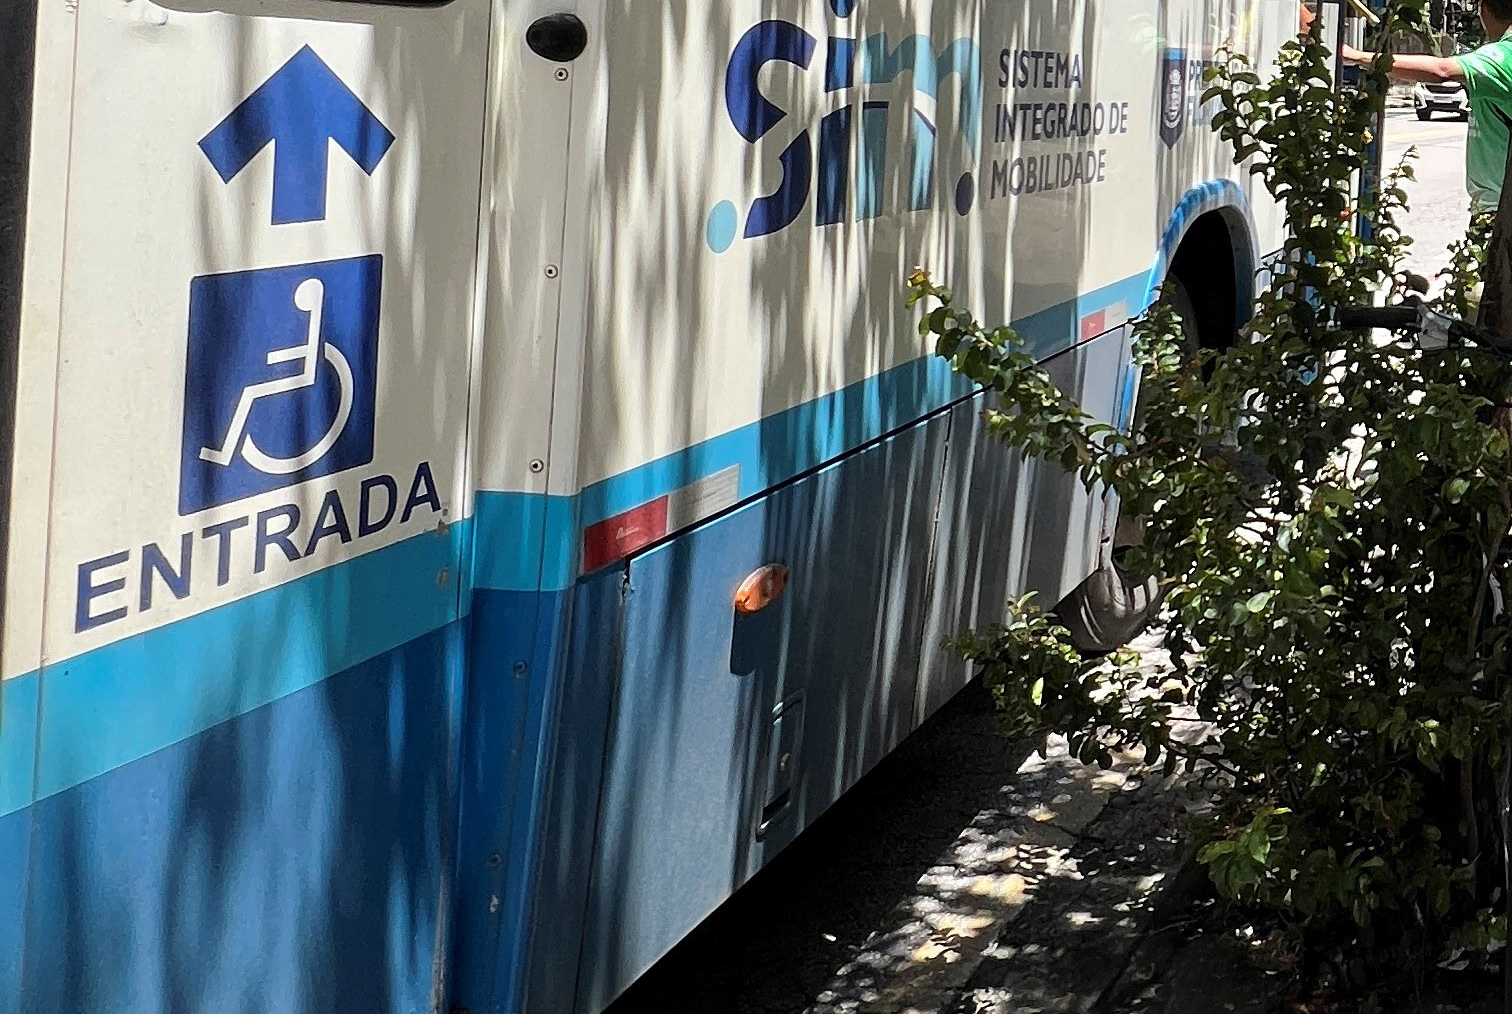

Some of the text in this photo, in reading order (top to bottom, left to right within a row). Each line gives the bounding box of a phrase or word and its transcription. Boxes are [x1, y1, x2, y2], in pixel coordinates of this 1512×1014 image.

[999, 48, 1083, 88] SISTEMA
[994, 102, 1129, 143] INTEGRADO DE
[990, 149, 1107, 200] MOBILIDADE
[74, 461, 442, 634] ENTRADA
